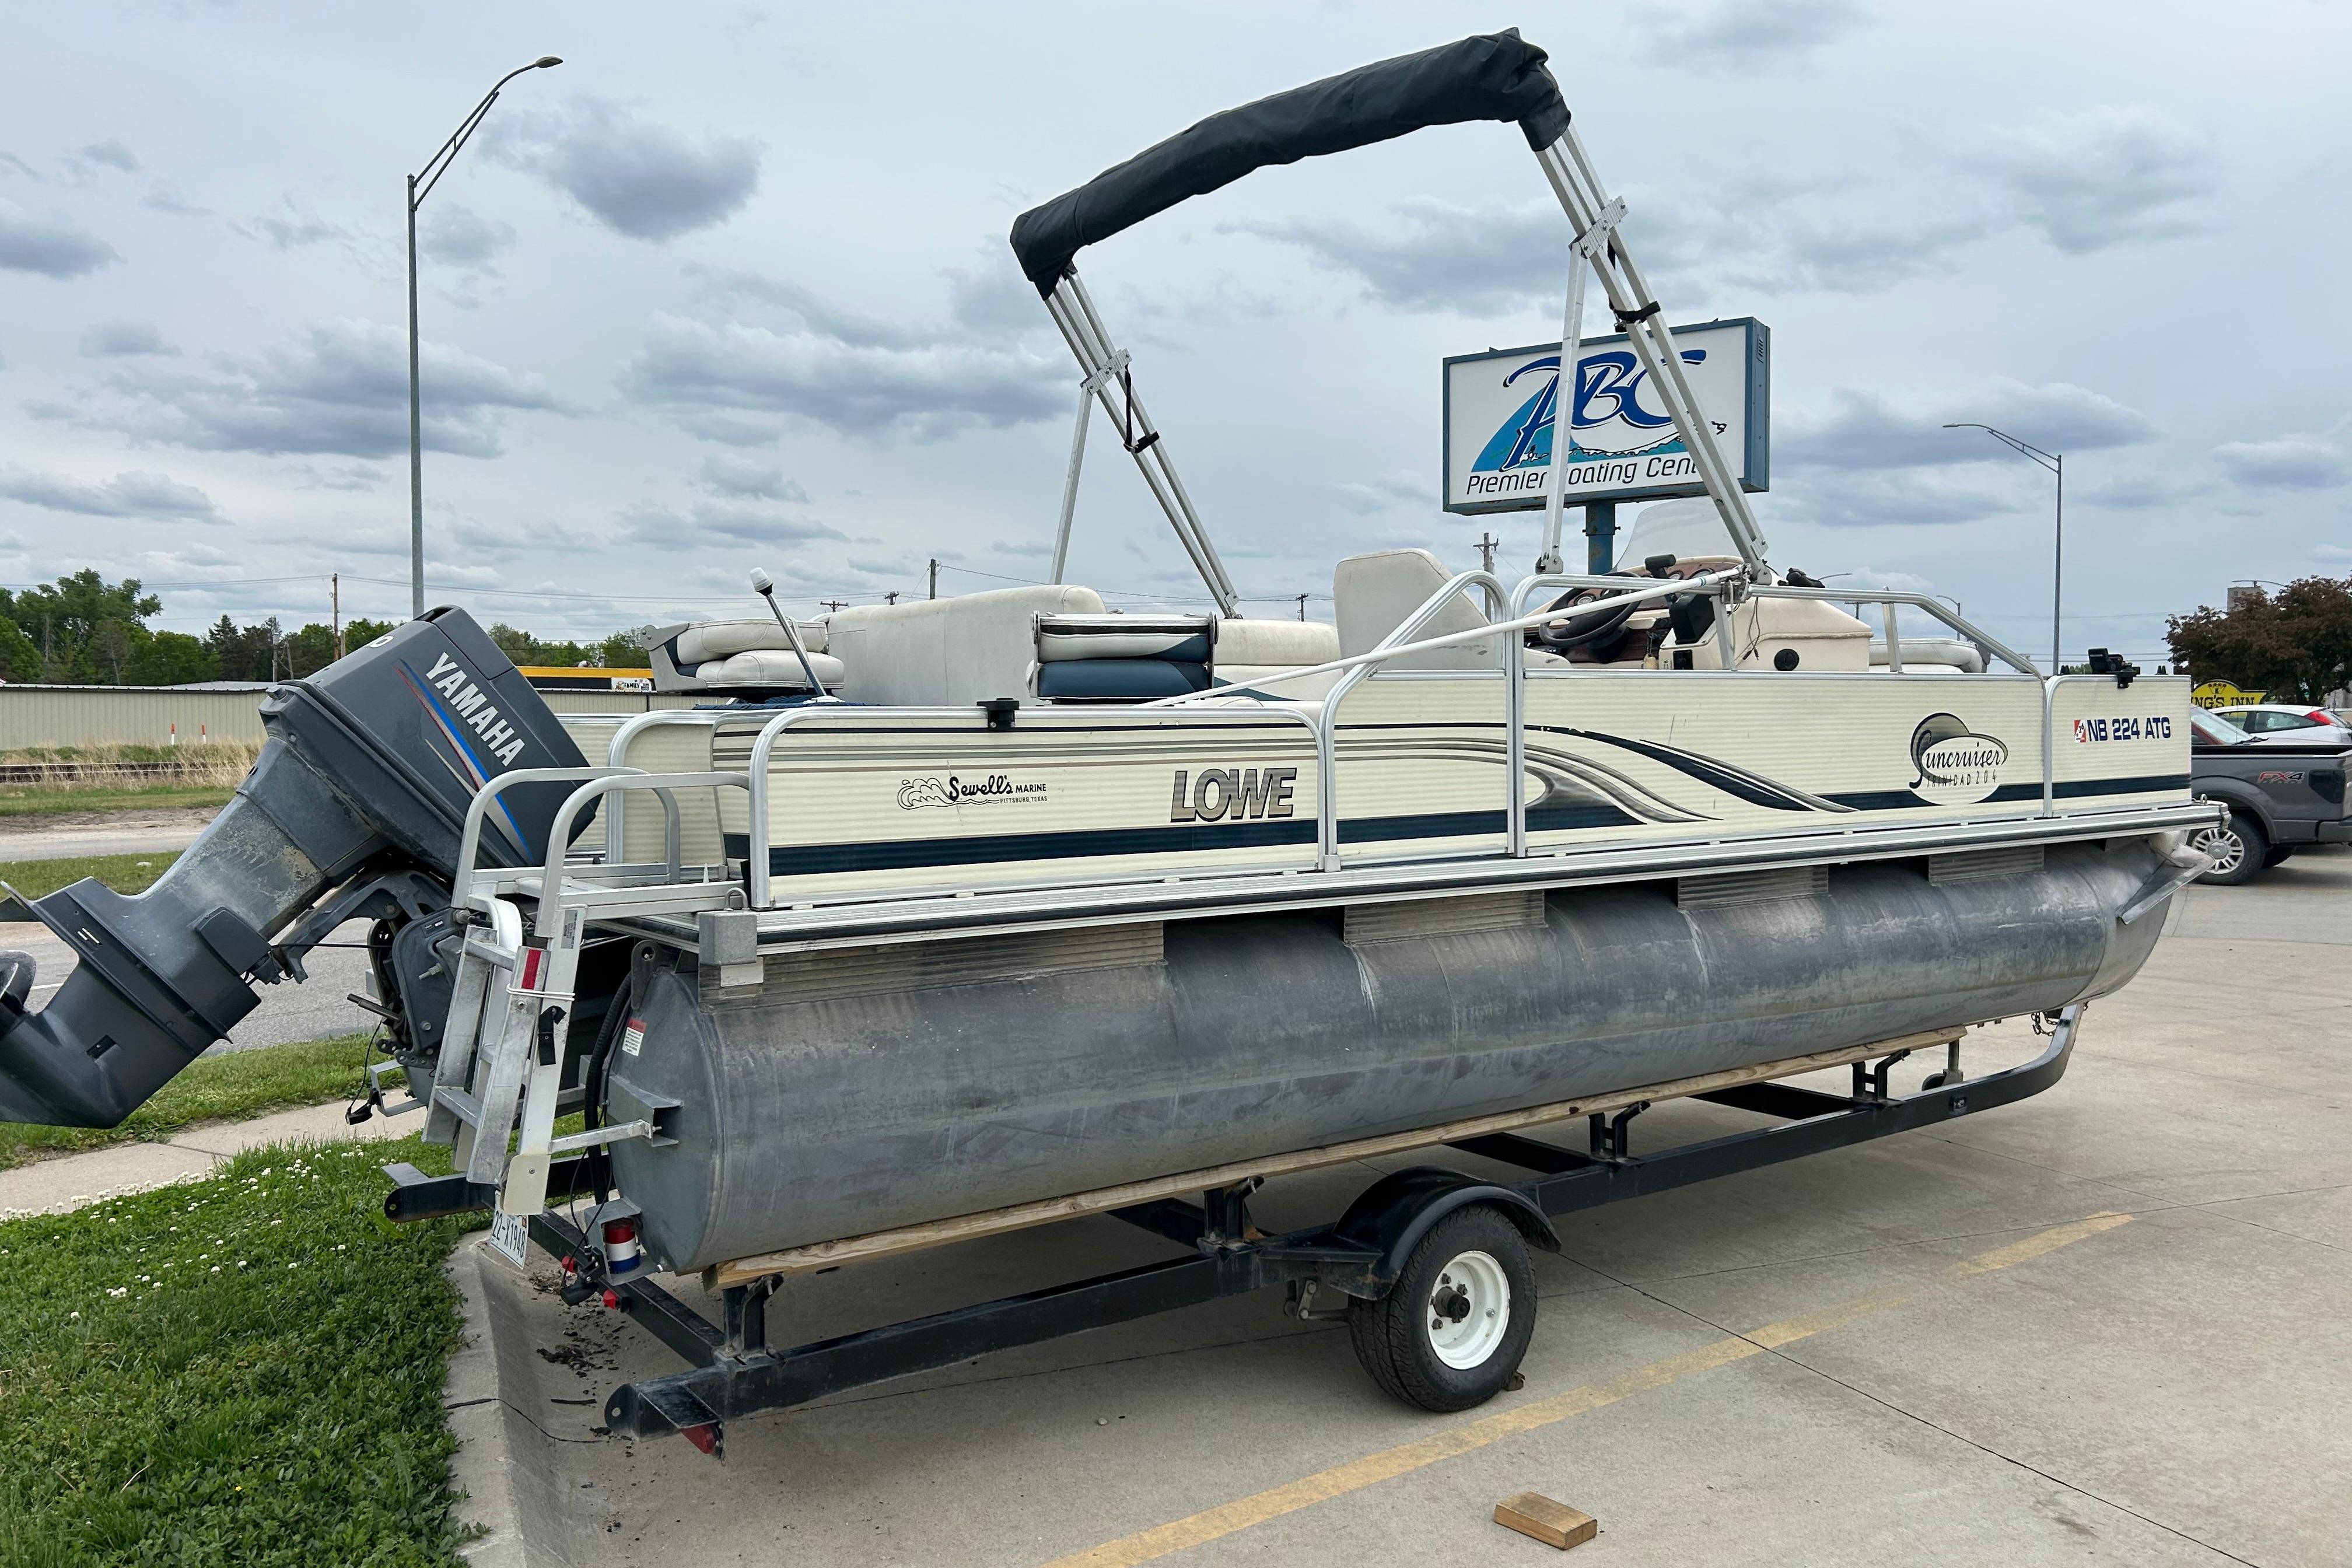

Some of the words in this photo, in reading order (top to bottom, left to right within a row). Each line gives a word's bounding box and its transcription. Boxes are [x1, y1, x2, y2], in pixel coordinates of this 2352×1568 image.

[1466, 470, 1548, 495] Premier
[1566, 461, 1637, 485] oating
[425, 651, 526, 767] YAMAHA
[2087, 719, 2108, 741] NB
[2112, 718, 2140, 740] 224
[2144, 716, 2171, 739] ATG
[949, 775, 1014, 801] Sewell's
[1016, 783, 1046, 793] MARINE
[1927, 773, 1972, 788] TRINIDAD
[1976, 769, 1996, 785] 204
[2258, 771, 2305, 782] FX4
[1171, 767, 1297, 822] LOWE
